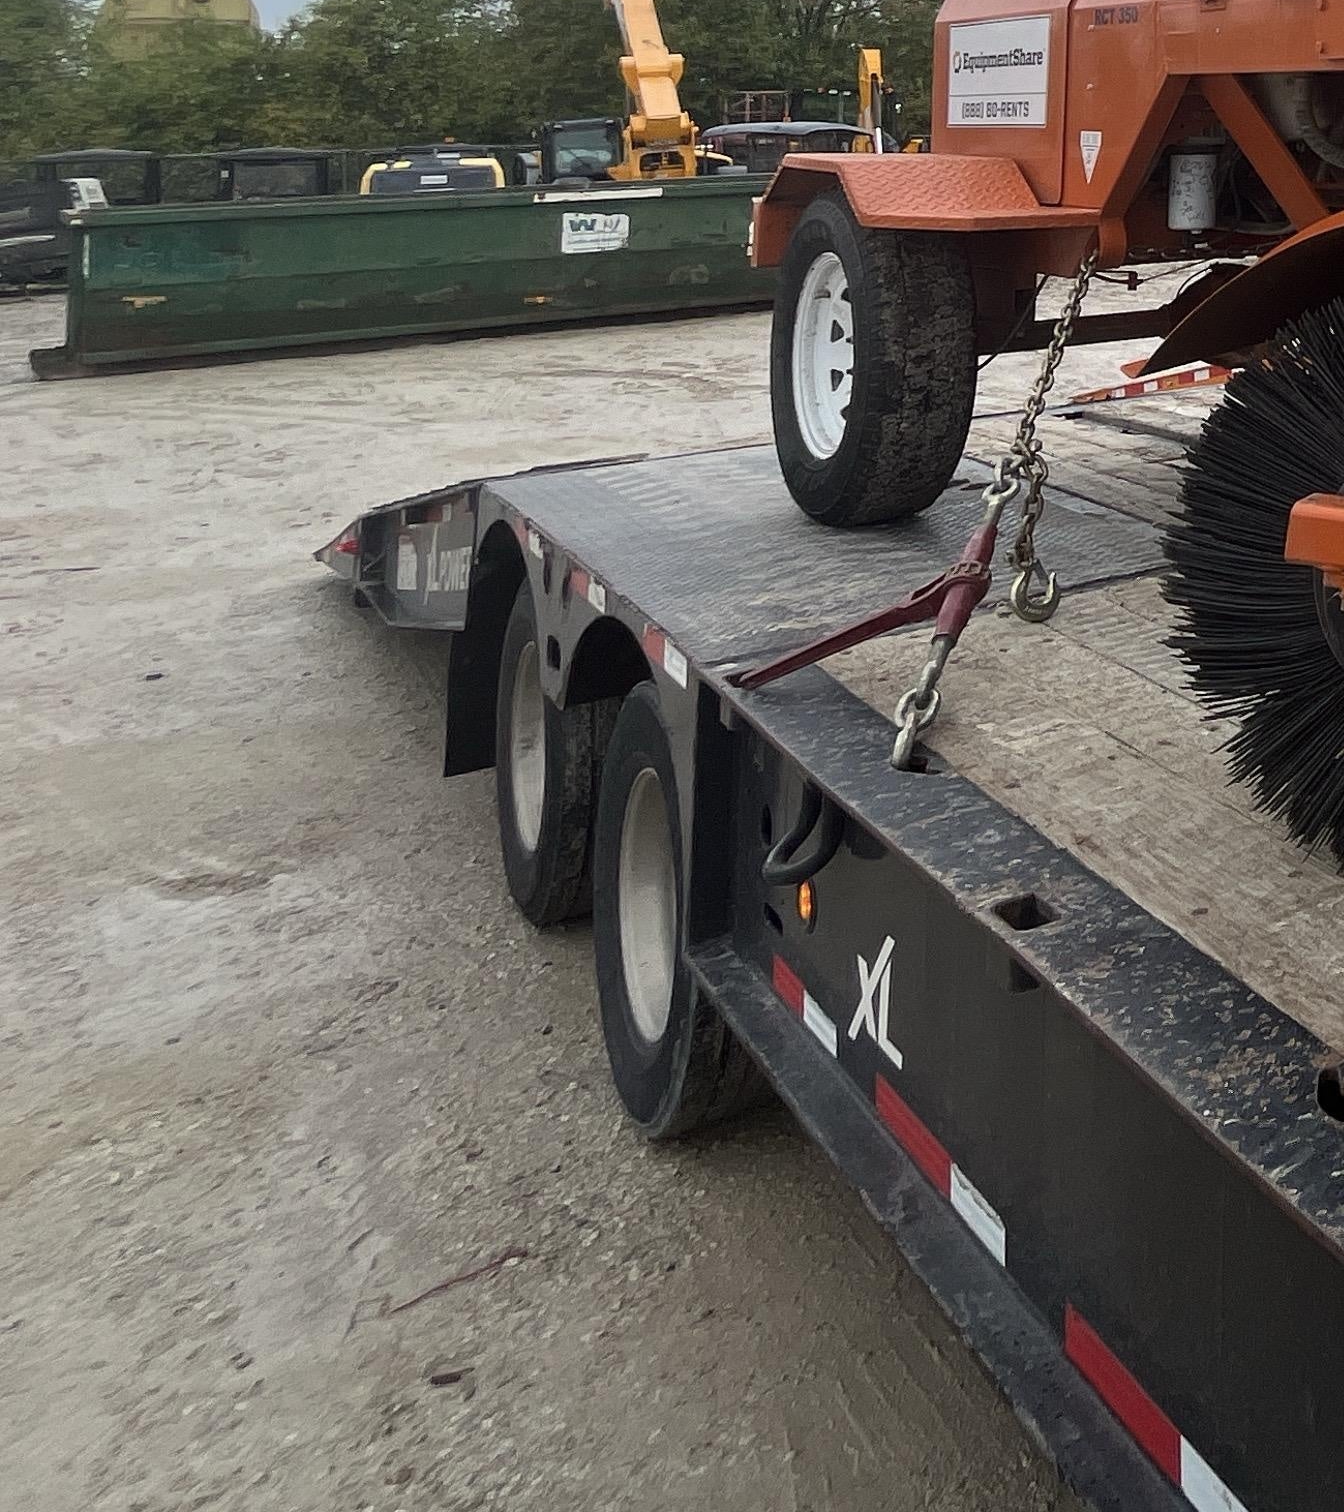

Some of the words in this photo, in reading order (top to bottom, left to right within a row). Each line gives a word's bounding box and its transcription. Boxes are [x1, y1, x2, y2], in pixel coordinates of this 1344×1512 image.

[1094, 8, 1116, 26] RCT
[1118, 6, 1138, 24] 350
[963, 48, 1044, 73] EquipmentShare
[962, 101, 984, 119] (888)
[848, 935, 903, 1070] XL
